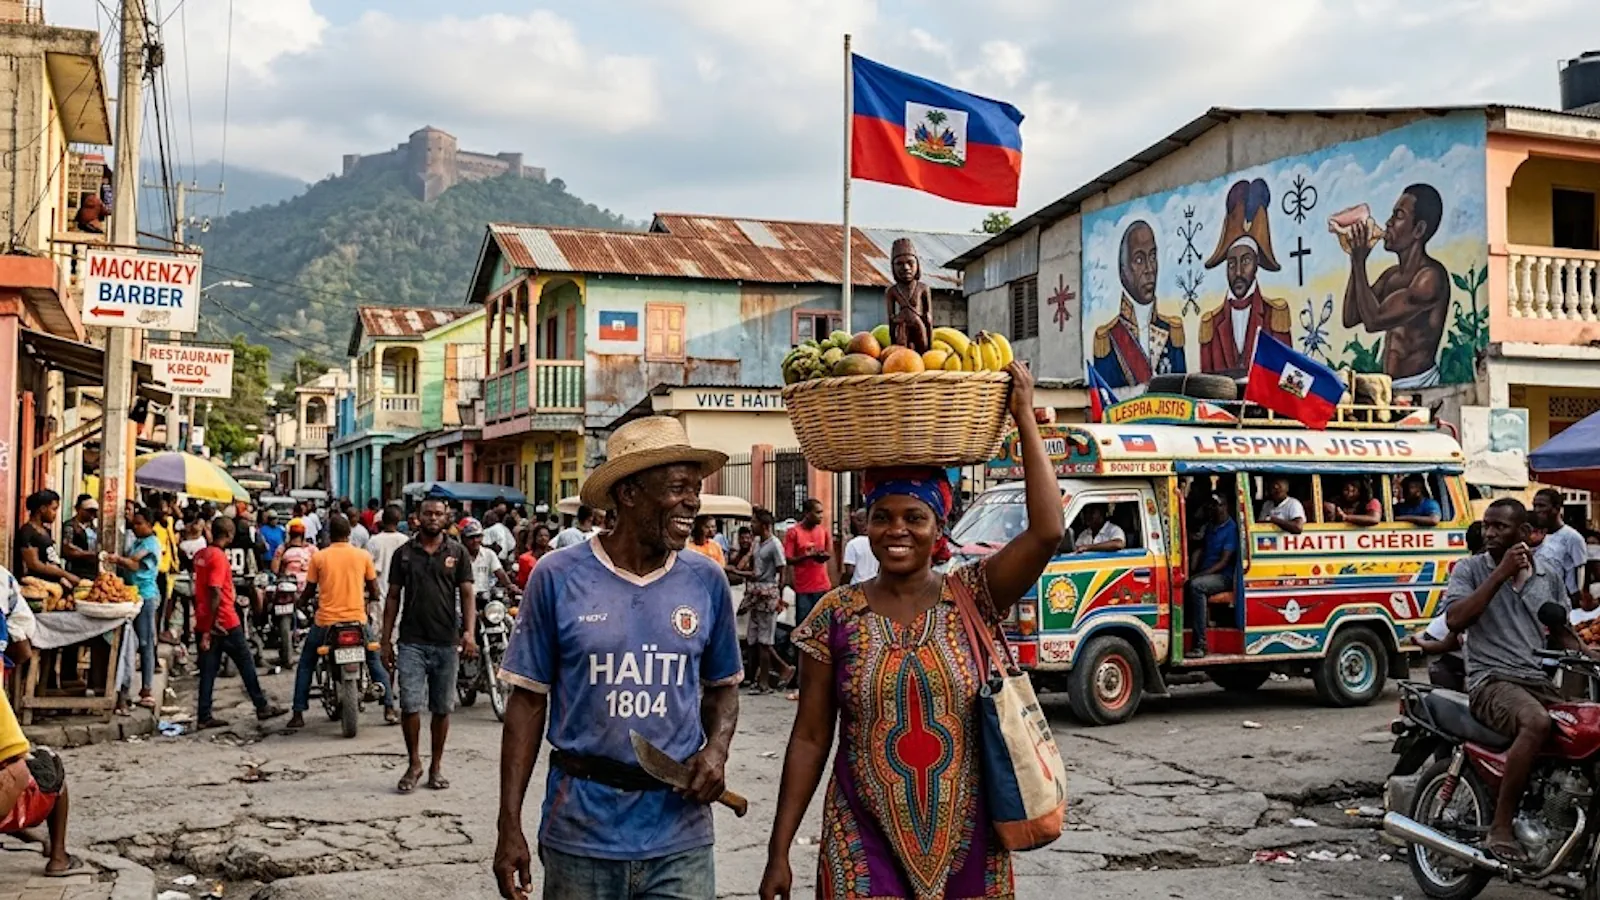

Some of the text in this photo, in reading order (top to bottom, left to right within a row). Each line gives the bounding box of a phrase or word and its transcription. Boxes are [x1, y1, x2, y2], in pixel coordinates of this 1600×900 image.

[90, 256, 196, 285] MACKENZY
[99, 282, 183, 308] BARBER
[150, 347, 230, 365] RESTAURANT
[167, 363, 211, 377] KREOL
[696, 393, 735, 407] VIVE
[1155, 400, 1186, 416] JISTIS
[1193, 431, 1413, 457] LÉSPWA JISTIS
[1283, 530, 1434, 550] HAITI CHÉRIE
[589, 644, 687, 686] HAÏTI
[606, 690, 667, 718] 1804
